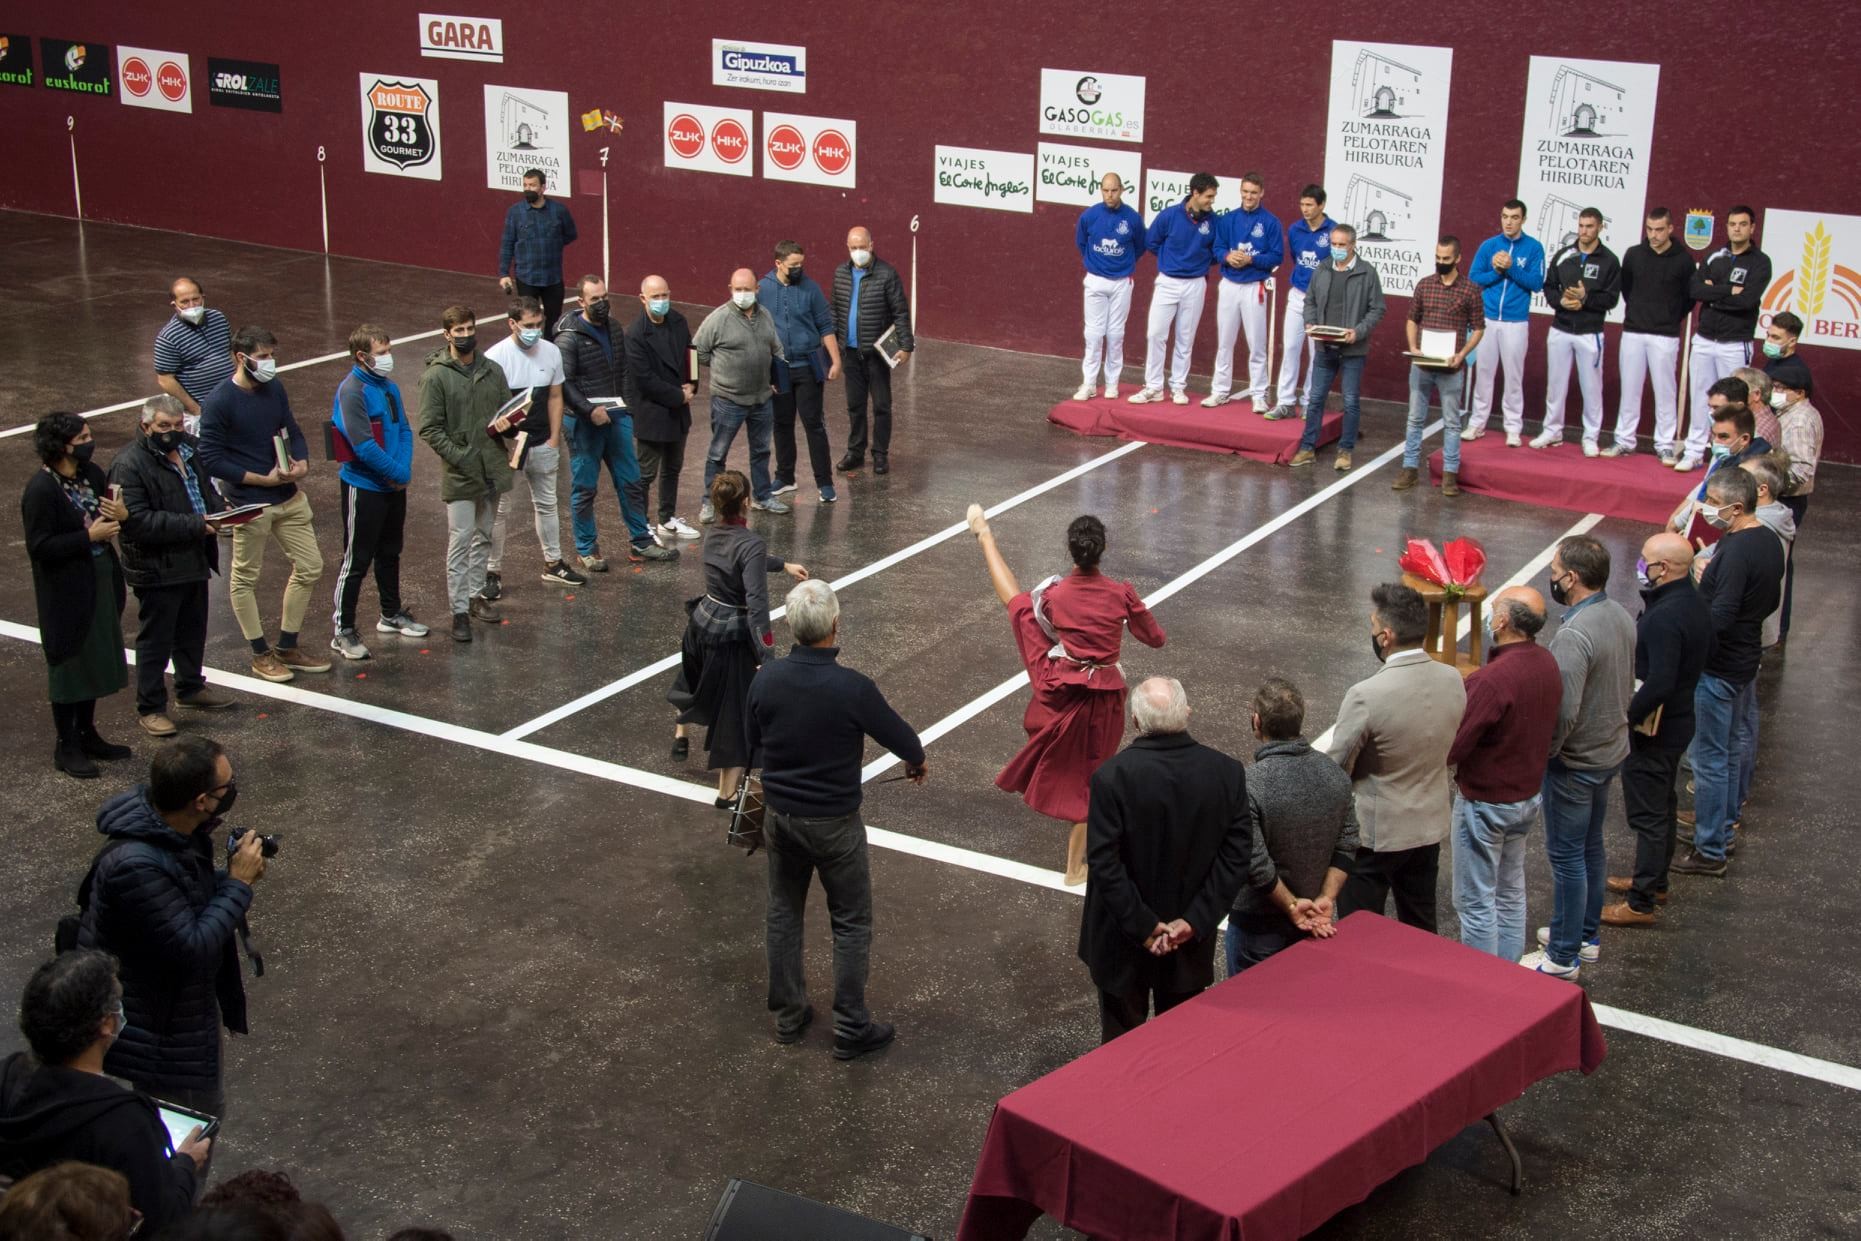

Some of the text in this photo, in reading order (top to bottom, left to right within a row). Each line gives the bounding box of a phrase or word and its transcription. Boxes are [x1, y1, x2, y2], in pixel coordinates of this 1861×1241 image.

[428, 21, 494, 50] GARA
[725, 52, 791, 73] Gipuzkoa
[377, 92, 422, 110] ROUTE
[67, 115, 74, 131] 9
[384, 115, 417, 144] 33
[1341, 121, 1431, 140] ZUMARRAGA
[317, 145, 326, 162] 8
[380, 144, 424, 157] GOURMET
[1343, 135, 1428, 155] PELOTAREN
[1537, 139, 1634, 160] ZUMARRAGA
[496, 151, 560, 168] ZUMARRAGA
[600, 146, 610, 167] 7
[939, 156, 986, 171] VIAJES
[1042, 153, 1091, 168] VIAJES
[1344, 150, 1424, 169] HIRIBURUA
[1538, 154, 1630, 175] PELOTAREN
[498, 163, 559, 180] PELOTEN
[938, 170, 952, 187] El
[952, 172, 984, 190] Corte
[1041, 168, 1055, 185] El
[1055, 171, 1088, 189] Corte
[1539, 169, 1625, 190] HIRIBURUA
[501, 175, 557, 191] HIRIUA
[1151, 180, 1192, 196] VIAJE
[910, 214, 920, 233] 6
[1353, 245, 1422, 264] MARRAGA
[1371, 261, 1419, 277] TAREN
